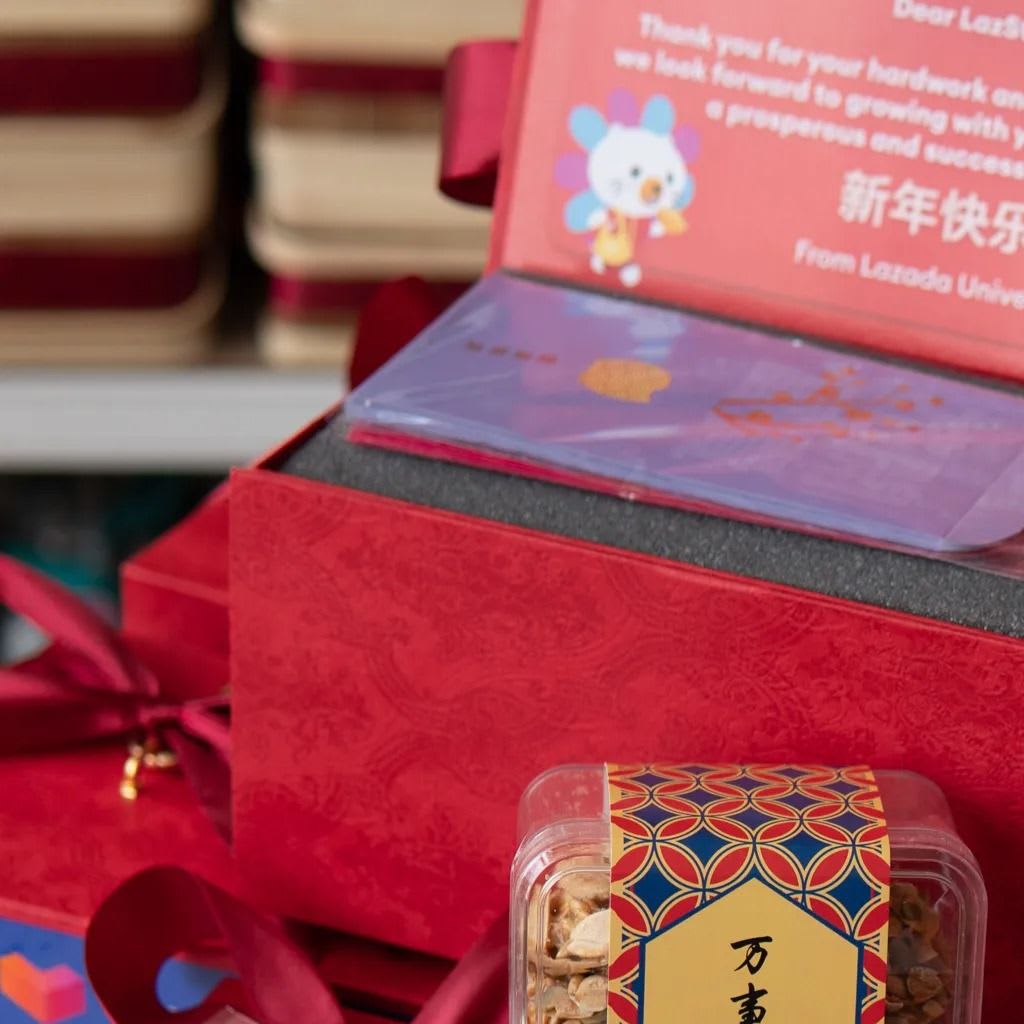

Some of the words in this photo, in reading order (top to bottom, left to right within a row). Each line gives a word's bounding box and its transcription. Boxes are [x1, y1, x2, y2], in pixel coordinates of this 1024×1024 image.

[893, 0, 955, 26] Dear
[640, 11, 709, 48] Thank
[715, 33, 763, 60] you
[767, 37, 802, 66] for
[806, 53, 863, 79] your
[866, 56, 988, 104] hardwork
[613, 47, 650, 72] we
[654, 50, 705, 83] look
[711, 60, 811, 104] forward
[814, 83, 842, 109] to
[845, 93, 949, 135] growing
[952, 112, 1010, 142] with
[705, 98, 724, 120] a
[725, 103, 867, 149] prosperous
[869, 132, 921, 160] and
[794, 237, 856, 275] From
[859, 253, 953, 295] Lazada
